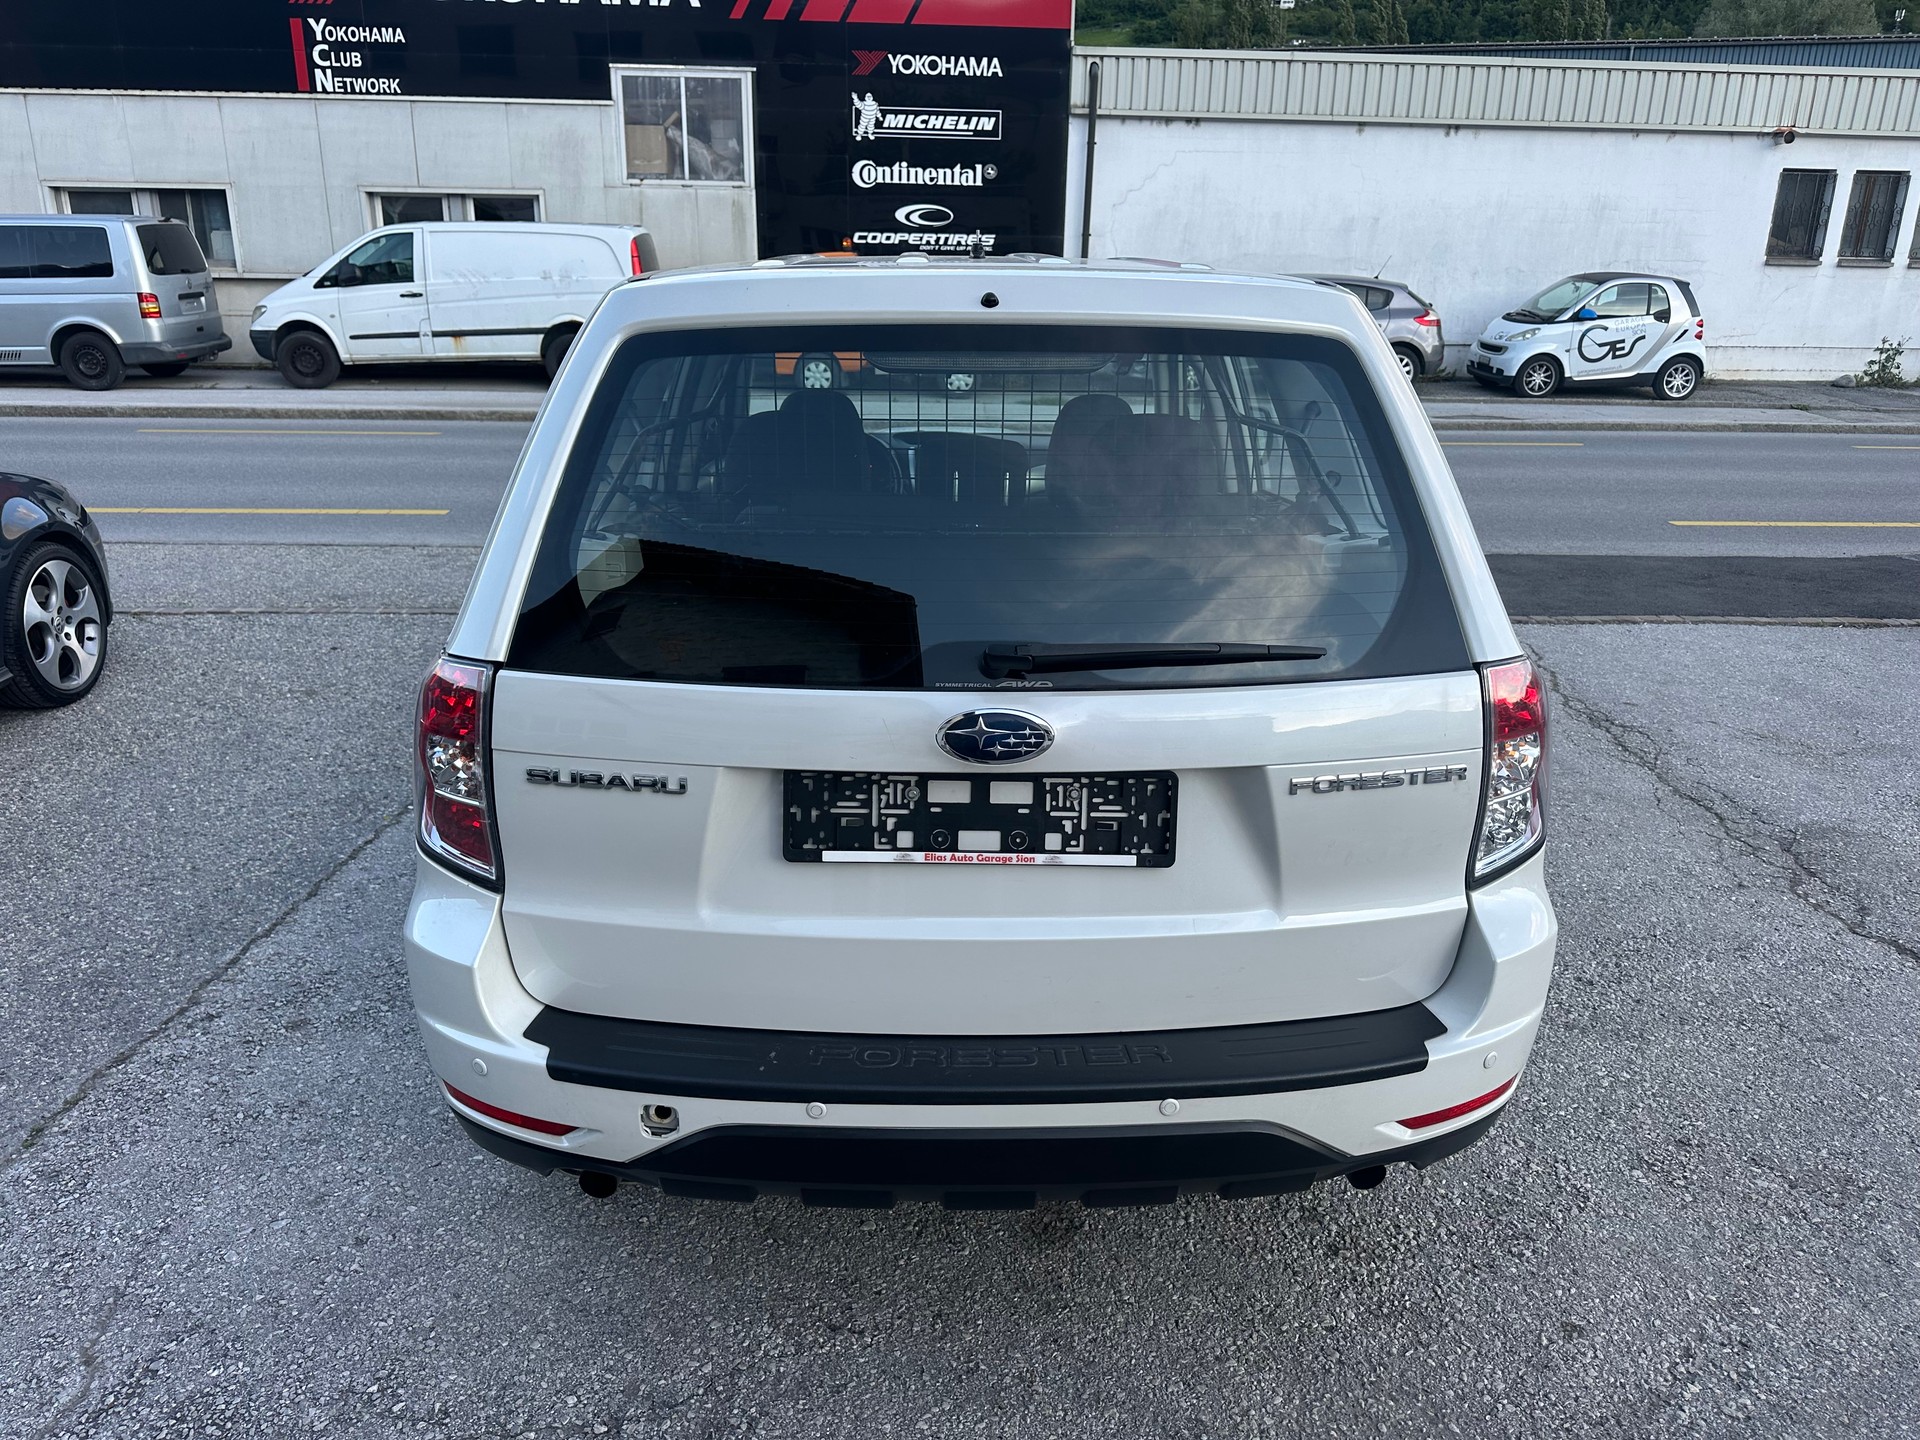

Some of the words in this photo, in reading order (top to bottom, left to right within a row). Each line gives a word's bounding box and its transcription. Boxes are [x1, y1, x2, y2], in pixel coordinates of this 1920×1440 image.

[307, 18, 406, 43] YOKOHAMA
[312, 44, 362, 67] CLUB
[887, 53, 1003, 77] YOKOHAMA
[314, 68, 401, 93] NETWORK
[882, 114, 997, 131] MICHELIN
[852, 159, 983, 188] Continental
[525, 767, 688, 795] SUBARU
[1289, 763, 1468, 795] FORESTER
[924, 853, 947, 862] Elias
[949, 853, 974, 862] Auto
[976, 853, 1013, 864] Garage
[1015, 853, 1036, 863] Sion
[809, 1043, 1174, 1068] FORESTER
